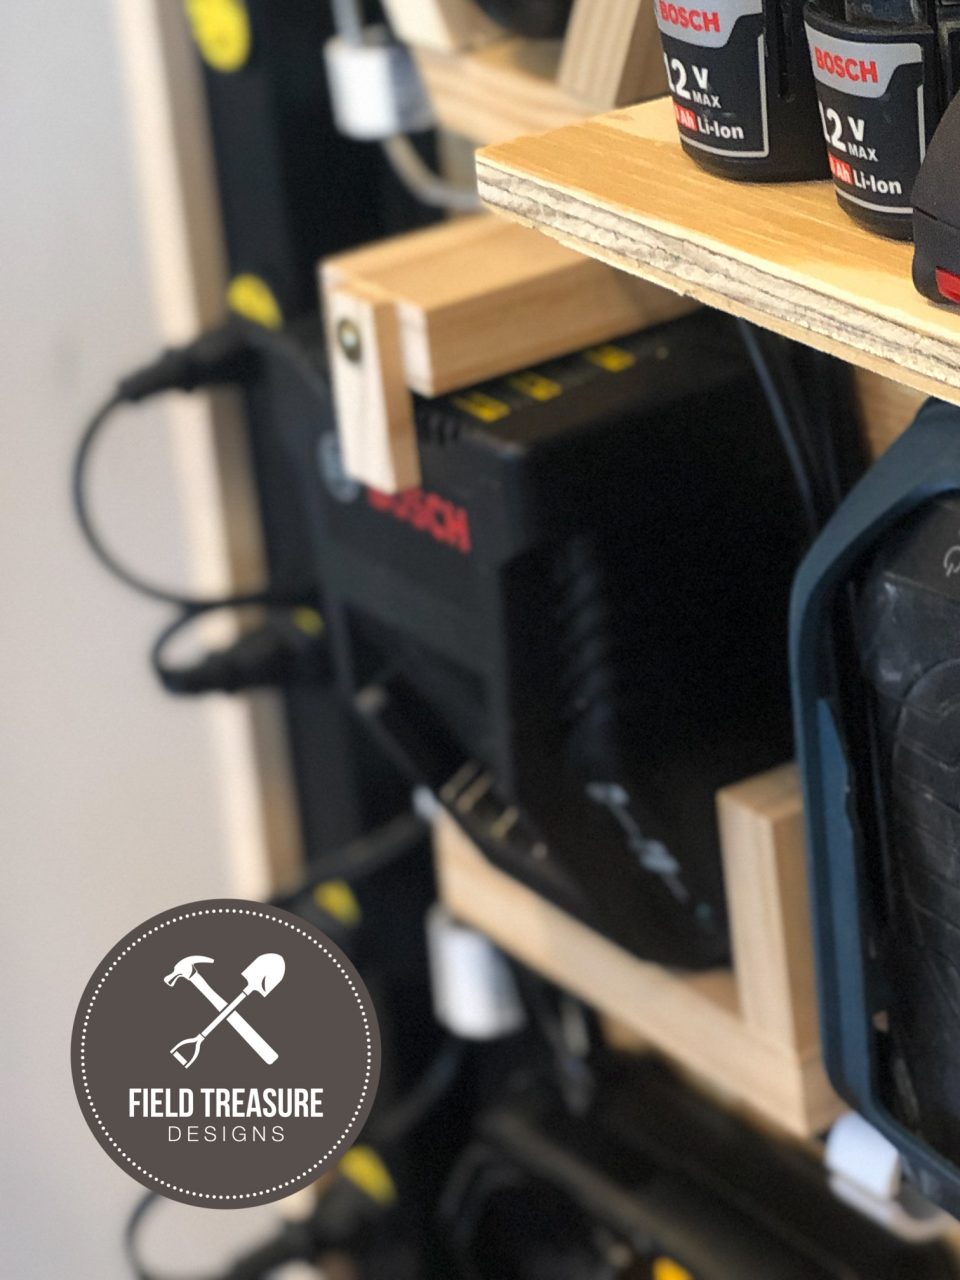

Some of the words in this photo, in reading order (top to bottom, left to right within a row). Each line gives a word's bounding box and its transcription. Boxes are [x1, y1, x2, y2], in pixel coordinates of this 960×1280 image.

[658, 0, 720, 33] BOSCH
[691, 64, 708, 91] V
[814, 46, 878, 84] BOSCH
[692, 89, 722, 109] MAX
[697, 114, 744, 140] Li-Ion
[847, 115, 865, 142] V
[847, 141, 879, 162] MAX
[852, 168, 902, 195] Li-Ion
